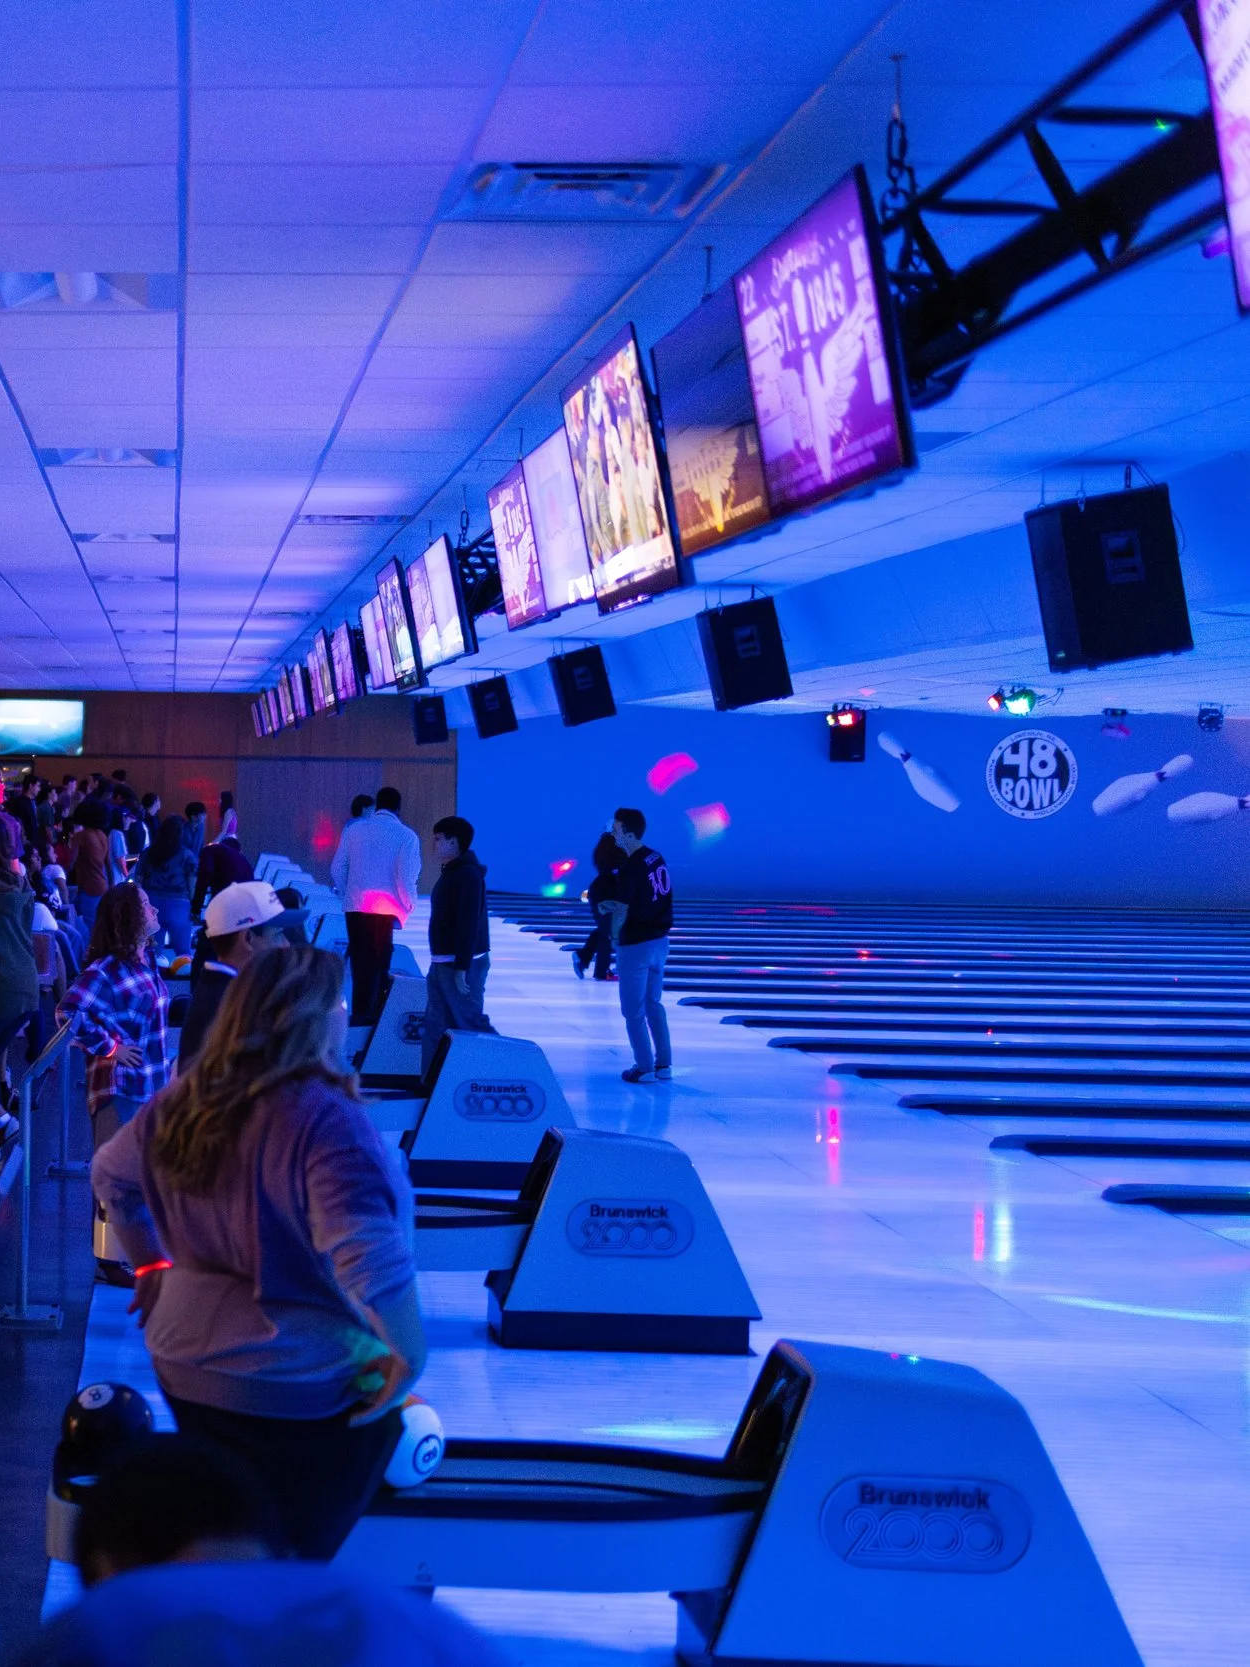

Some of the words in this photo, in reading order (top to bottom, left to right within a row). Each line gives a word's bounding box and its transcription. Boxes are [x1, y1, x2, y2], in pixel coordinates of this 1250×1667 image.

[807, 260, 847, 333] 1845
[1002, 739, 1058, 778] 48
[1000, 777, 1063, 810] BOWL
[648, 866, 671, 901] 10
[470, 1083, 528, 1093] Brunswick
[590, 1204, 669, 1218] Brunswick
[581, 1218, 677, 1251] 2000
[859, 1483, 991, 1510] Brunswick
[844, 1507, 1004, 1562] 2000
